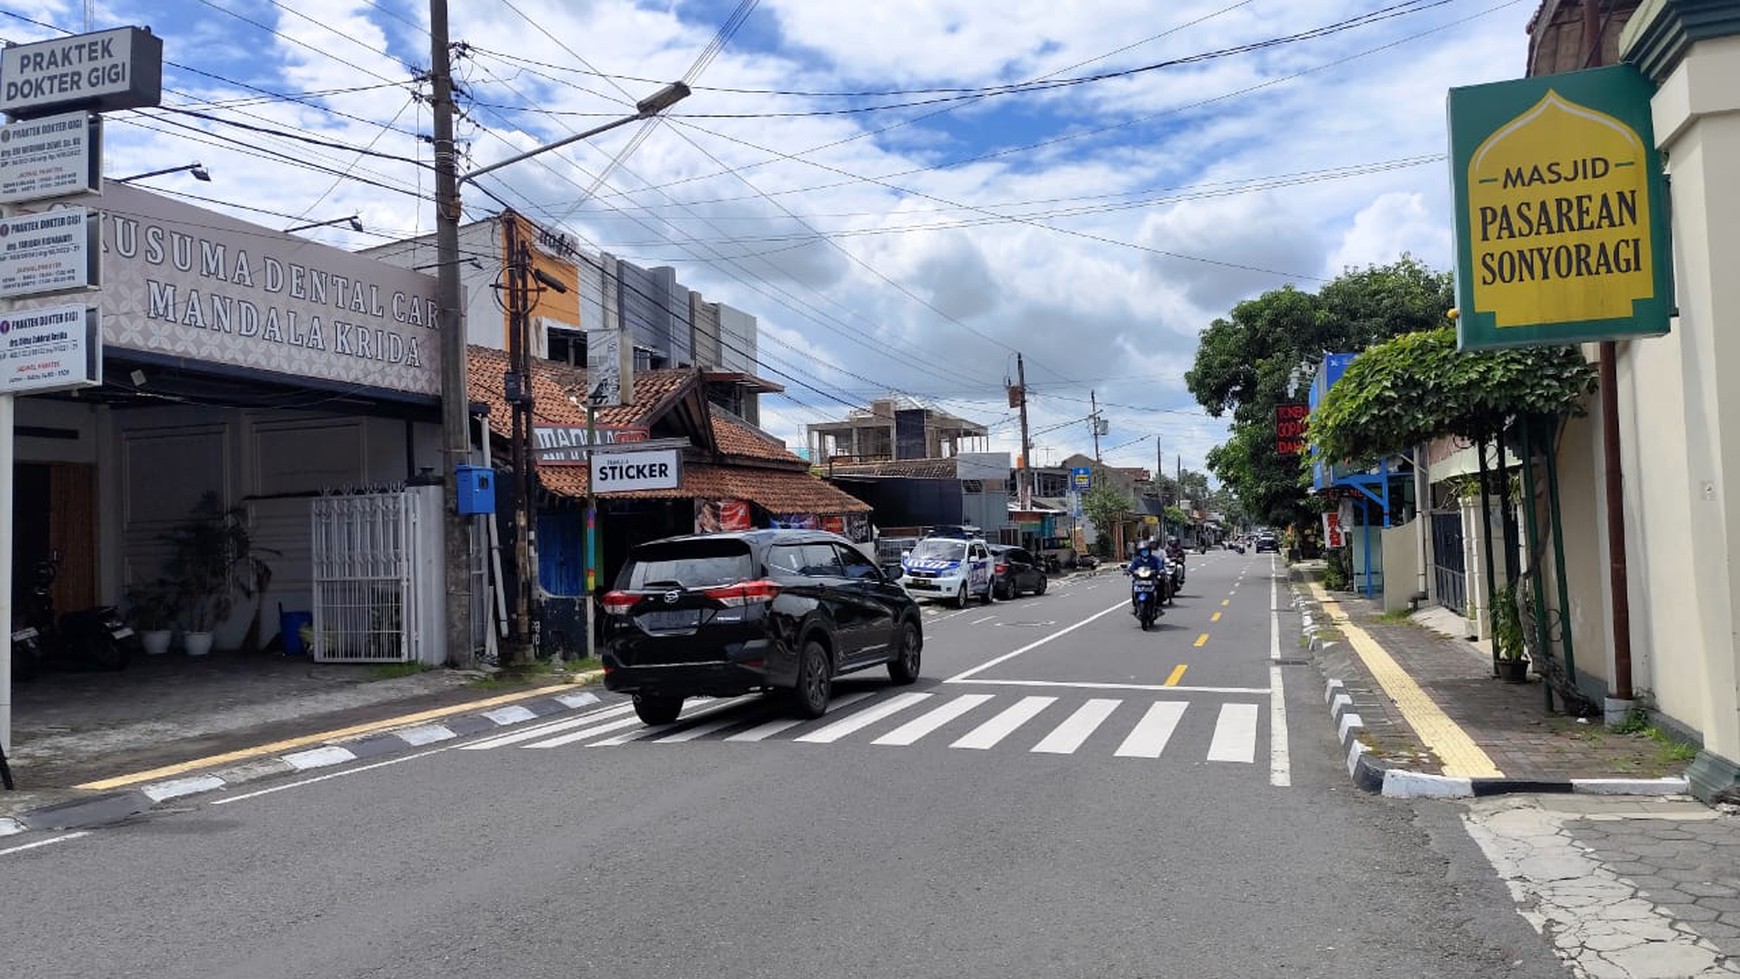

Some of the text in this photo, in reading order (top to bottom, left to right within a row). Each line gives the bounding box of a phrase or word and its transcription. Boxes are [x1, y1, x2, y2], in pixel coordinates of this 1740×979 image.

[20, 38, 114, 74] PRAKTEK
[6, 62, 126, 101] DOKTER GIGI
[1502, 157, 1610, 189] MASJID
[1479, 190, 1637, 241] PASAREAN
[1481, 239, 1642, 285] SONYORAGI
[264, 256, 384, 318] DENTAL
[147, 280, 422, 367] MANDALA KRIDA
[598, 463, 668, 481] STICKER
